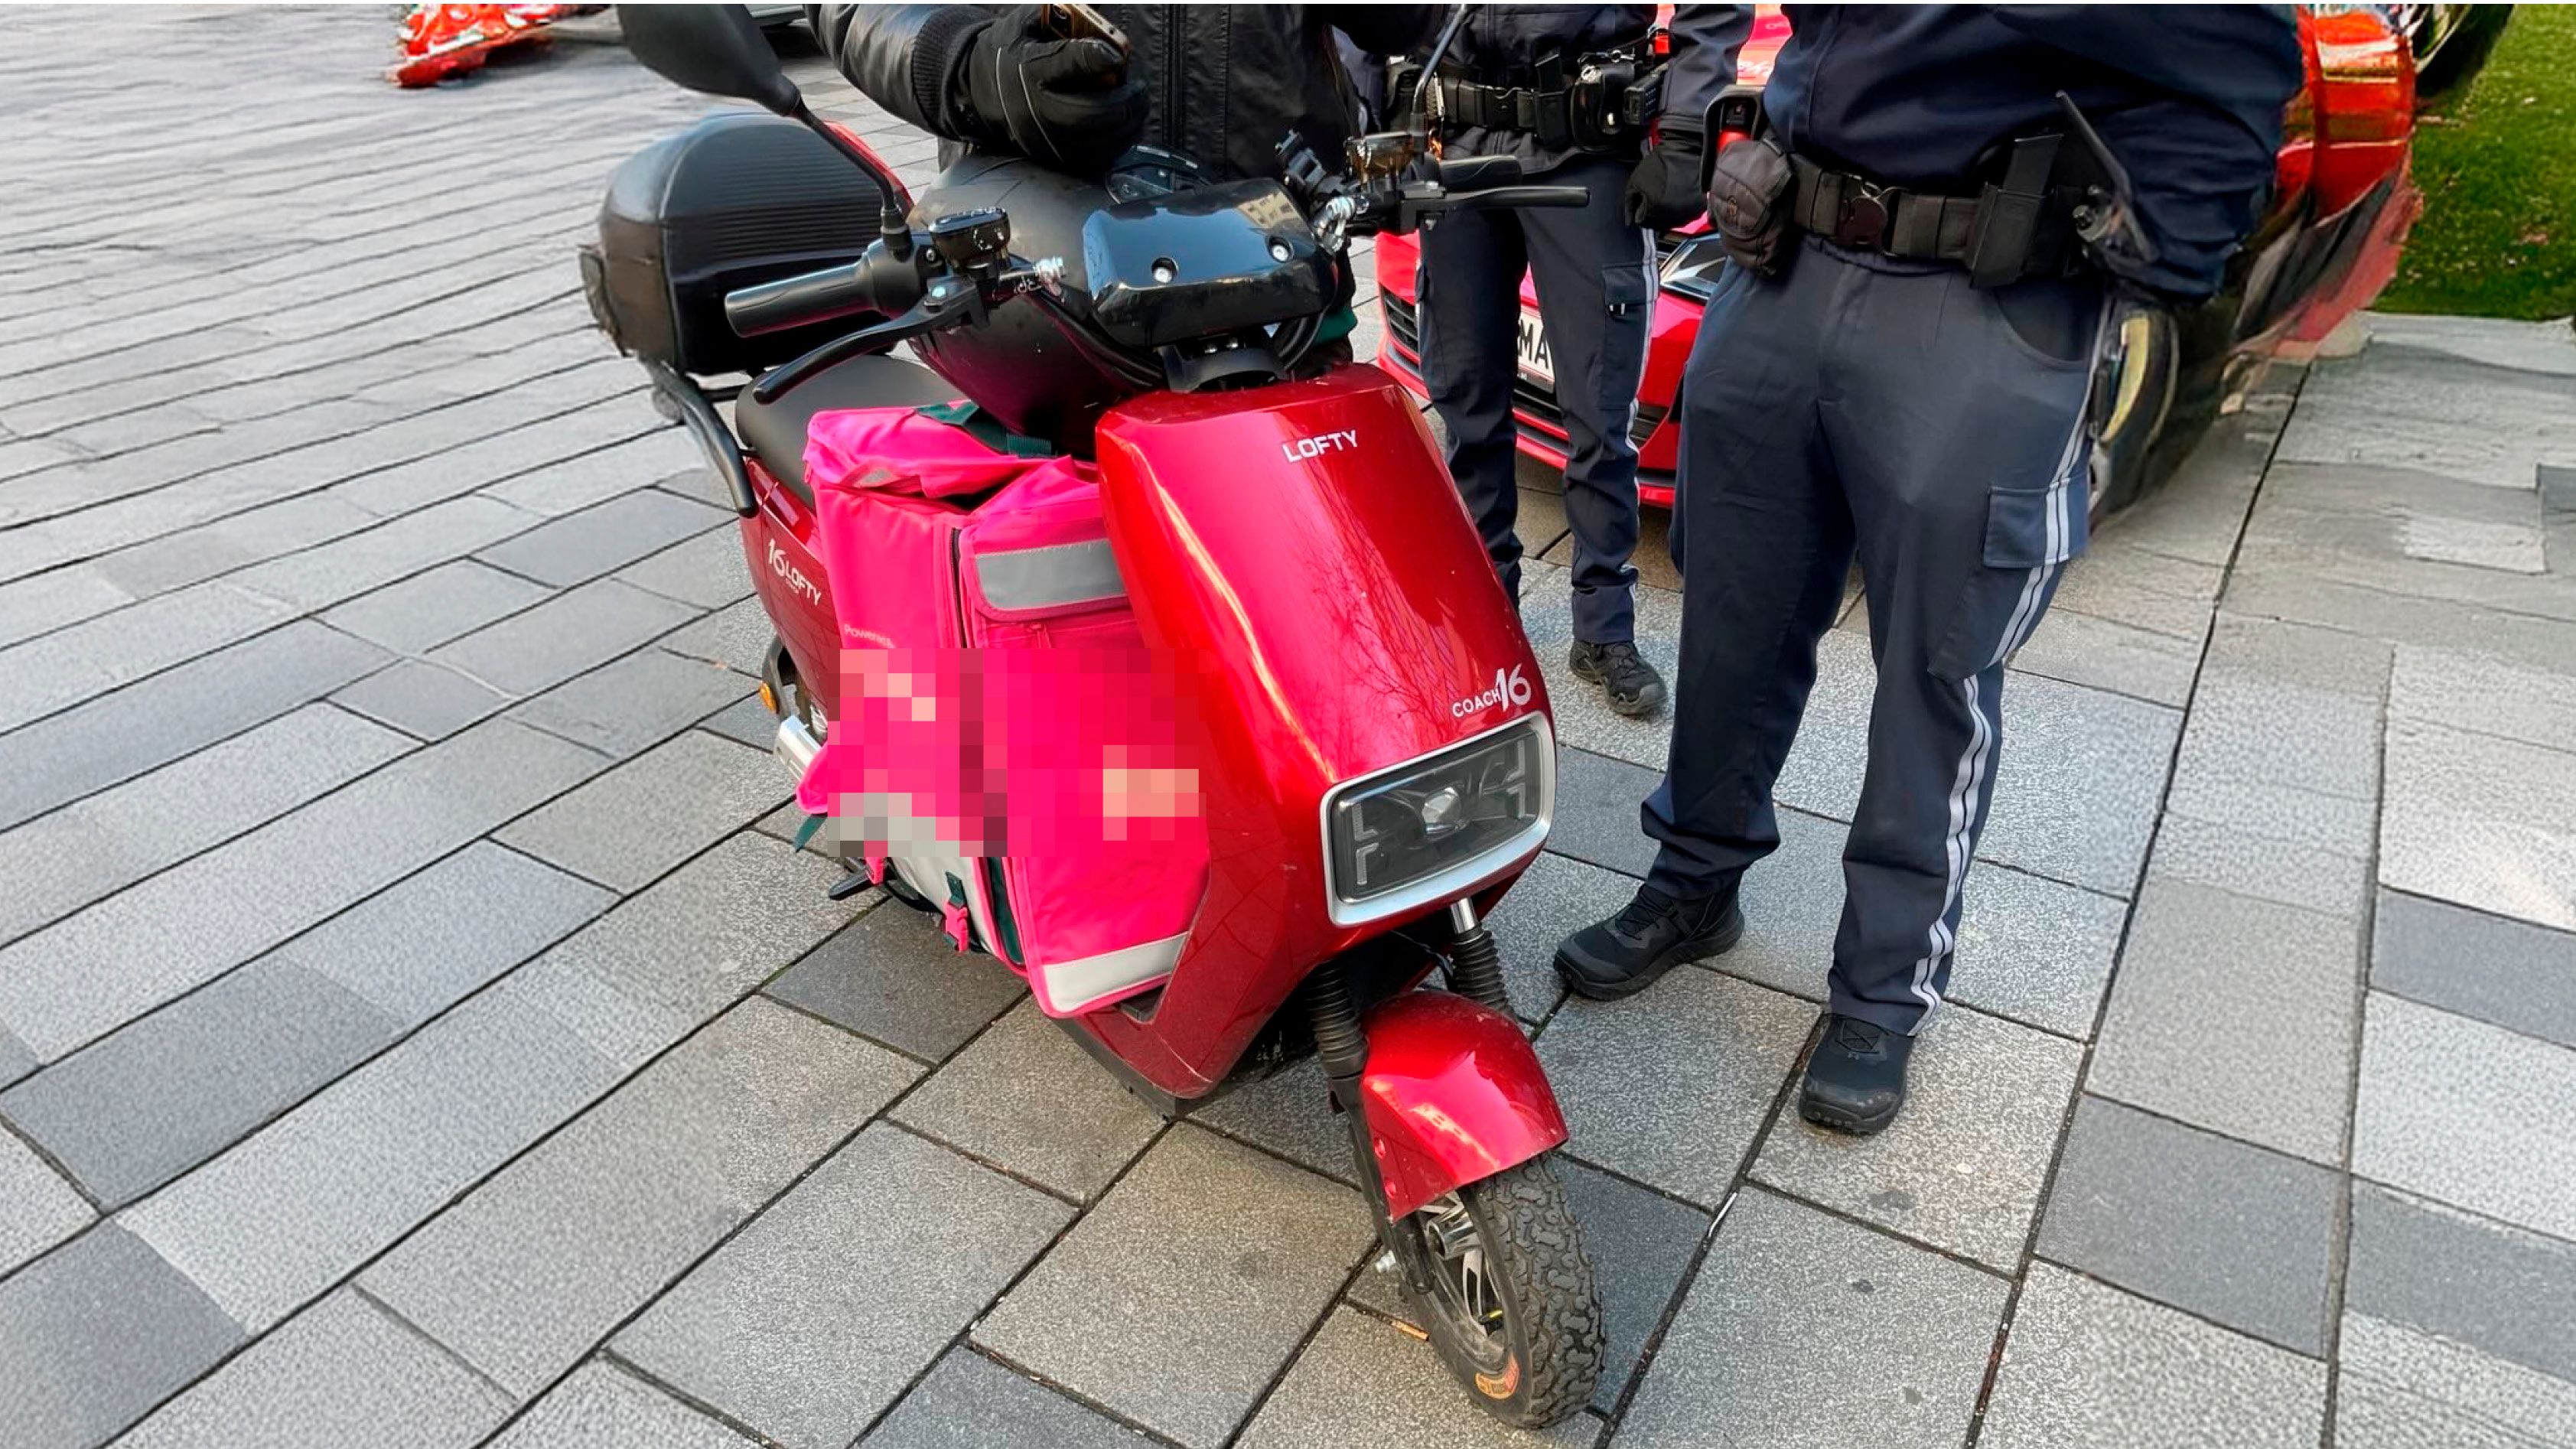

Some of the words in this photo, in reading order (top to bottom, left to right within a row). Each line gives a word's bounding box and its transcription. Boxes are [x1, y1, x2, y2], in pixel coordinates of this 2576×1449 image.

[1282, 429, 1358, 463] LOFTY
[769, 538, 786, 577] 16
[785, 560, 822, 606] LOFTY
[1452, 689, 1501, 718] COACH
[1496, 663, 1532, 712] 16
